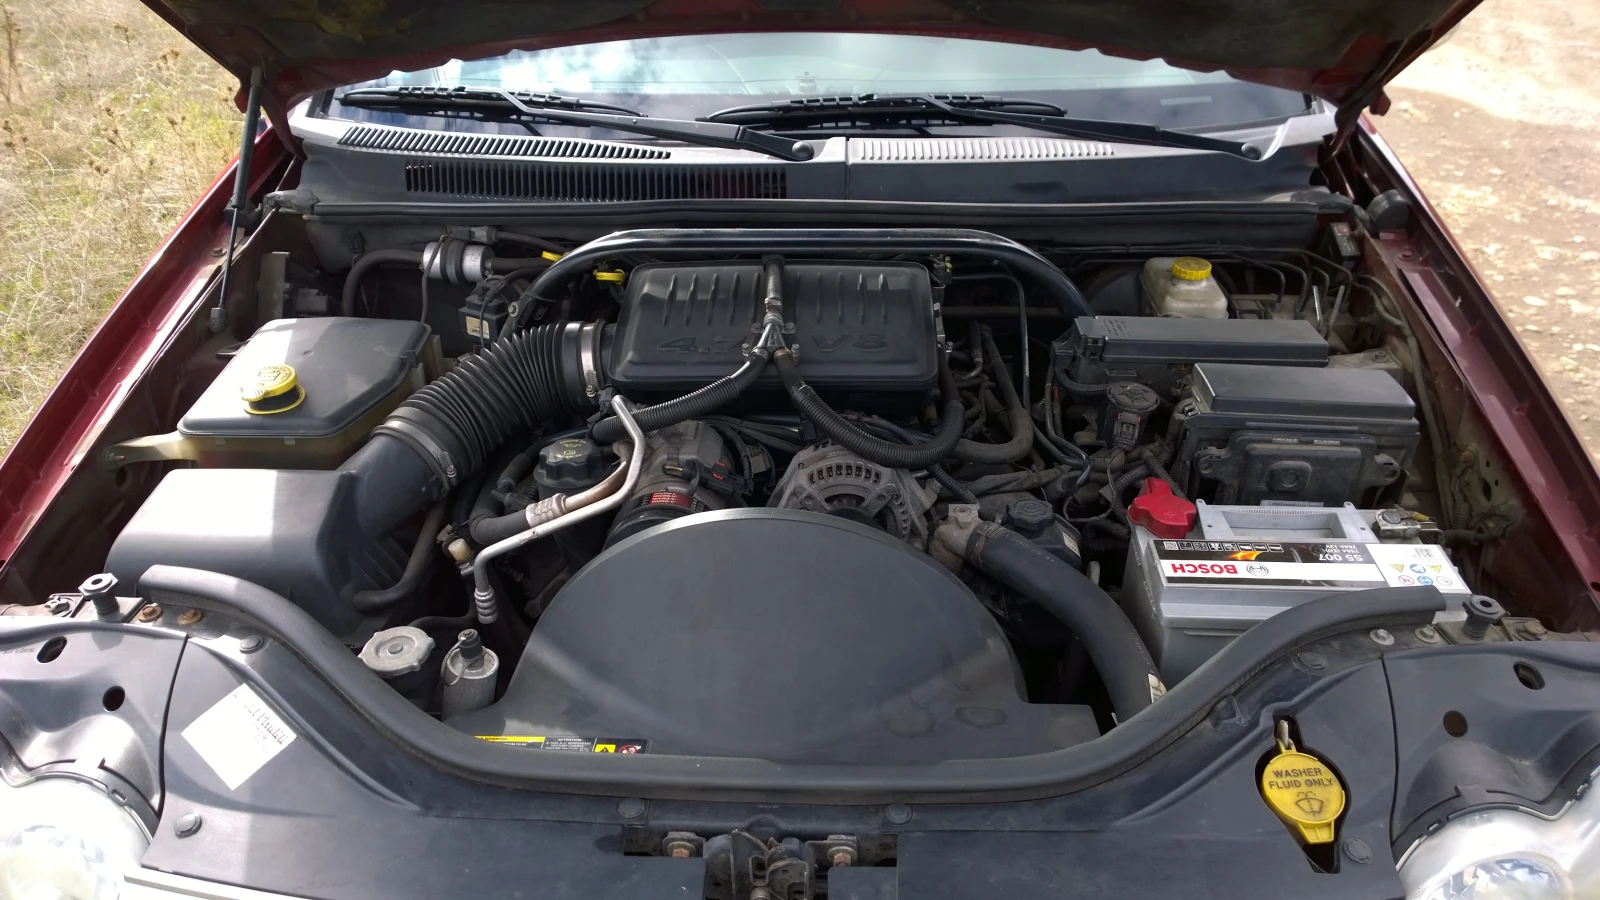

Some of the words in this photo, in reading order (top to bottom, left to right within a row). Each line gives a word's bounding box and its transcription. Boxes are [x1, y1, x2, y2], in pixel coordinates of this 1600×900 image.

[810, 333, 889, 352] V8
[1319, 553, 1343, 562] 007
[1345, 554, 1364, 562] S5
[1171, 563, 1239, 575] BOSCH
[1273, 767, 1323, 778] WASHER
[1268, 780, 1302, 789] FLUID
[1304, 777, 1334, 788] ONLY
